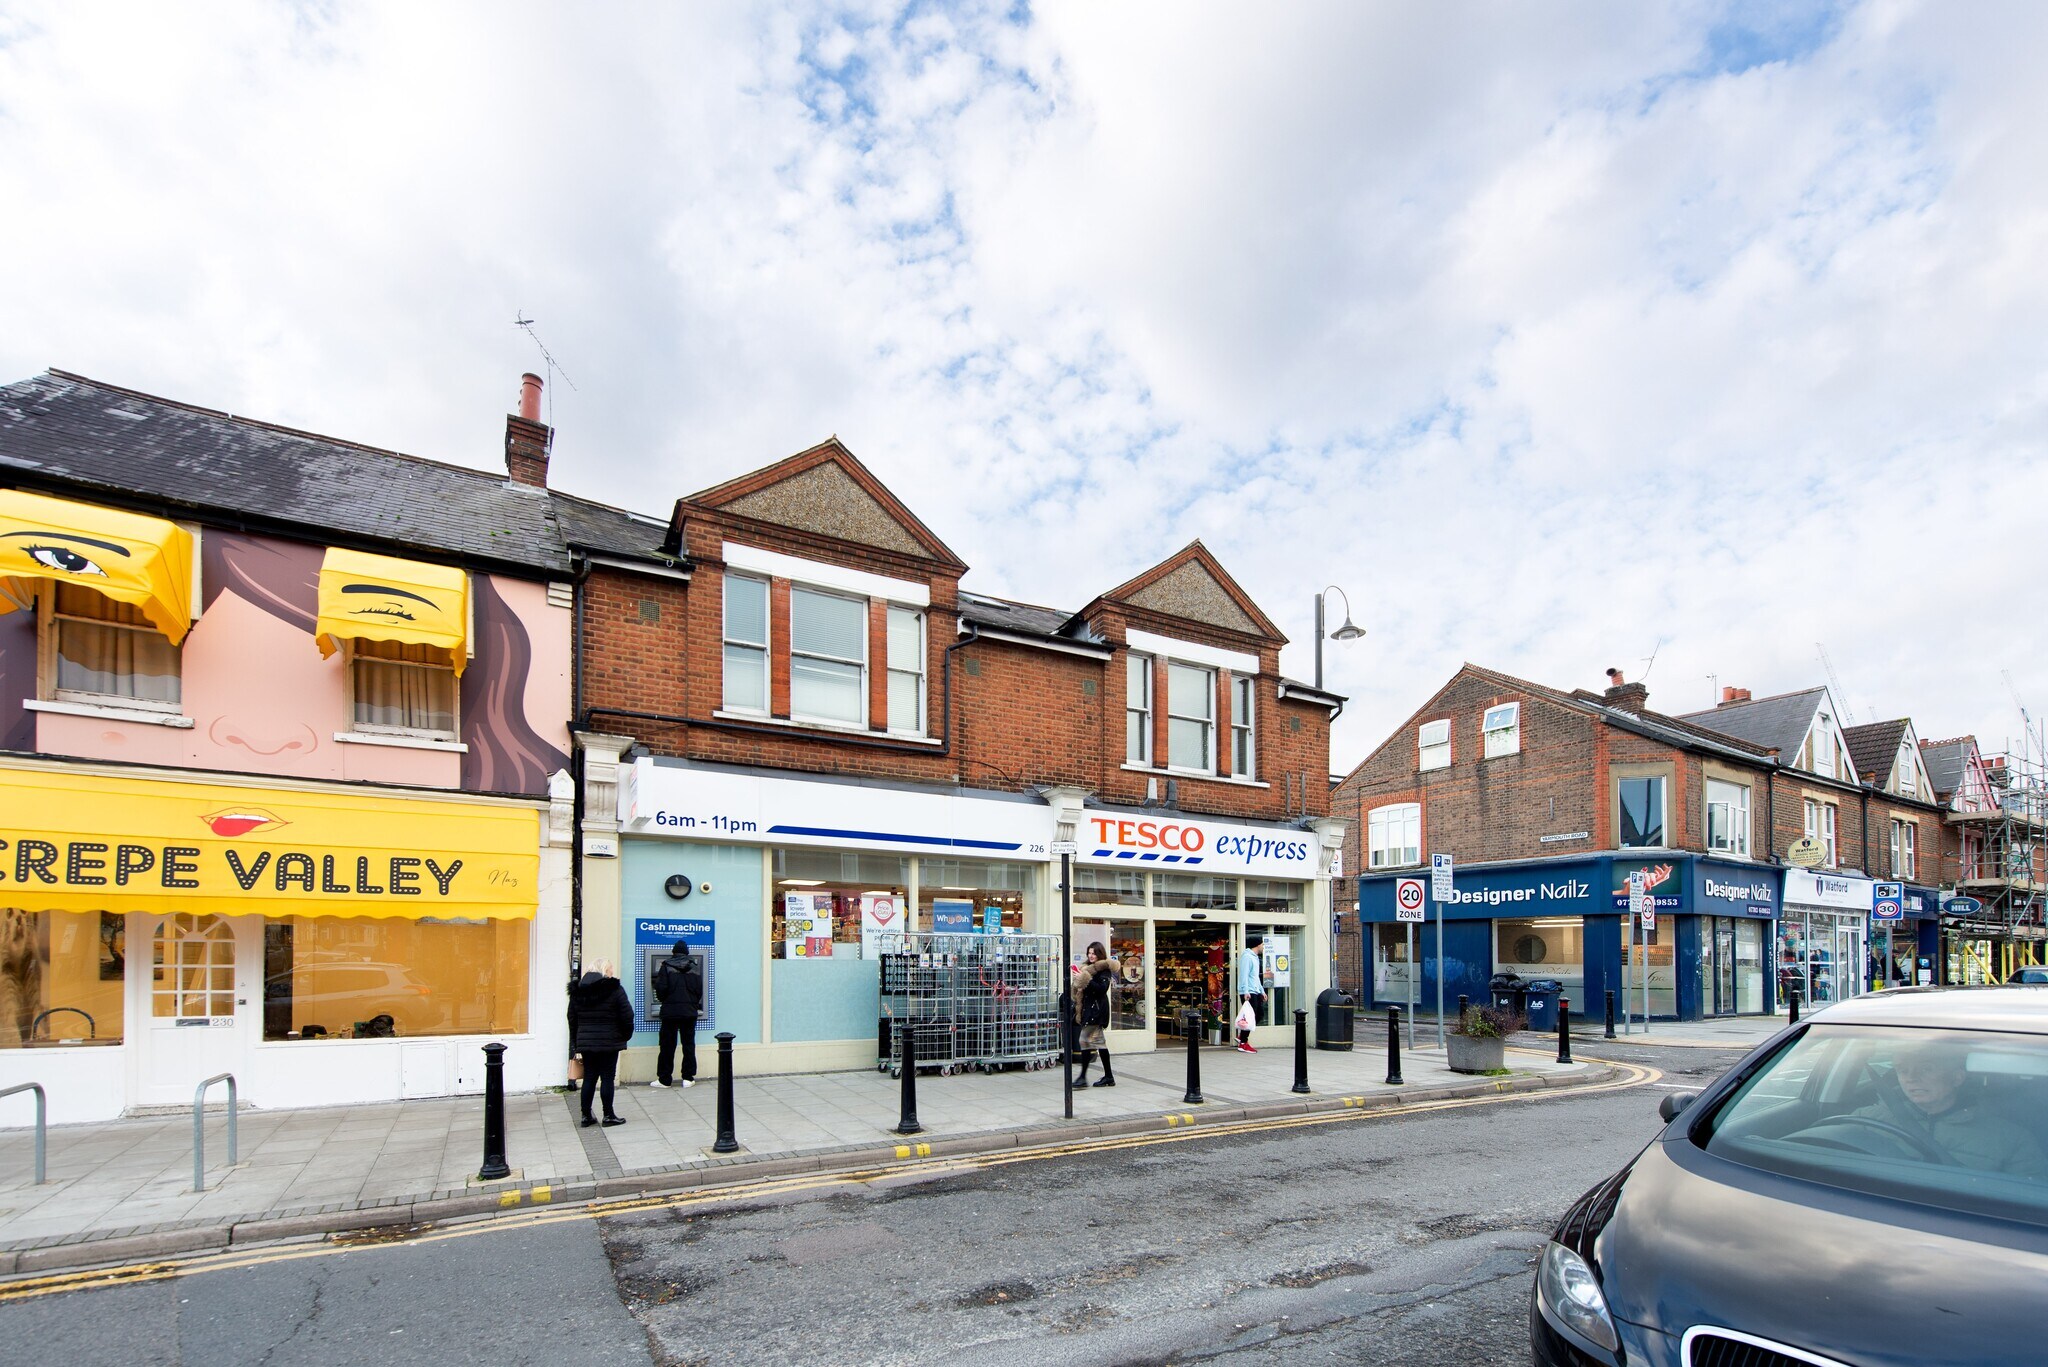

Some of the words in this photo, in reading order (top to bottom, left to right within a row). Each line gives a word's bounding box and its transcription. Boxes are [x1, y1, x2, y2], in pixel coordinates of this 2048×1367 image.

[655, 811, 696, 827] 6am
[711, 815, 757, 834] 11pm
[1090, 817, 1205, 852] TESCO
[1216, 834, 1308, 865] express
[1029, 844, 1045, 853] 226
[0, 839, 201, 888] REPE
[225, 849, 464, 896] VALLEY
[1435, 857, 1440, 867] P
[1448, 887, 1536, 905] Designer
[1540, 880, 1590, 900] Nailz
[1705, 879, 1750, 902] Designer
[1750, 883, 1772, 902] Nailz
[1825, 881, 1848, 893] Watford
[1402, 889, 1420, 901] 20
[1643, 903, 1652, 913] 20
[1399, 911, 1422, 919] ZONE
[640, 922, 666, 931] Cash
[668, 923, 711, 932] machine
[212, 1018, 234, 1027] 230
